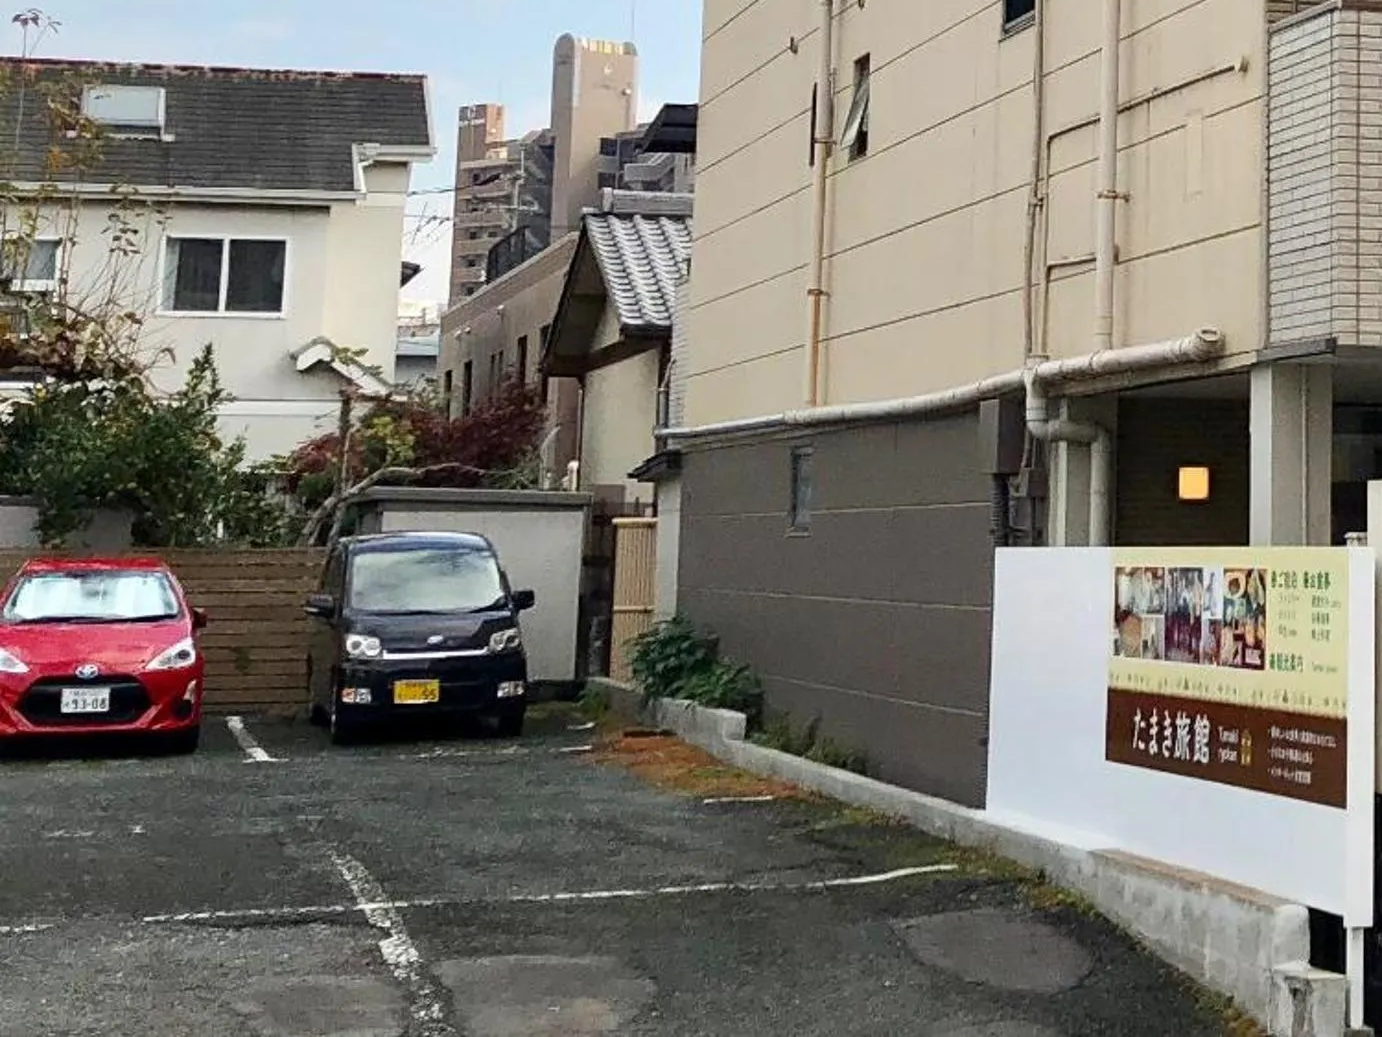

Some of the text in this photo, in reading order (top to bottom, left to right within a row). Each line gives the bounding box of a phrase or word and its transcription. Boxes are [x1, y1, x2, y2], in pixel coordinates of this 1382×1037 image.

[1132, 707, 1211, 765] たまき旅館
